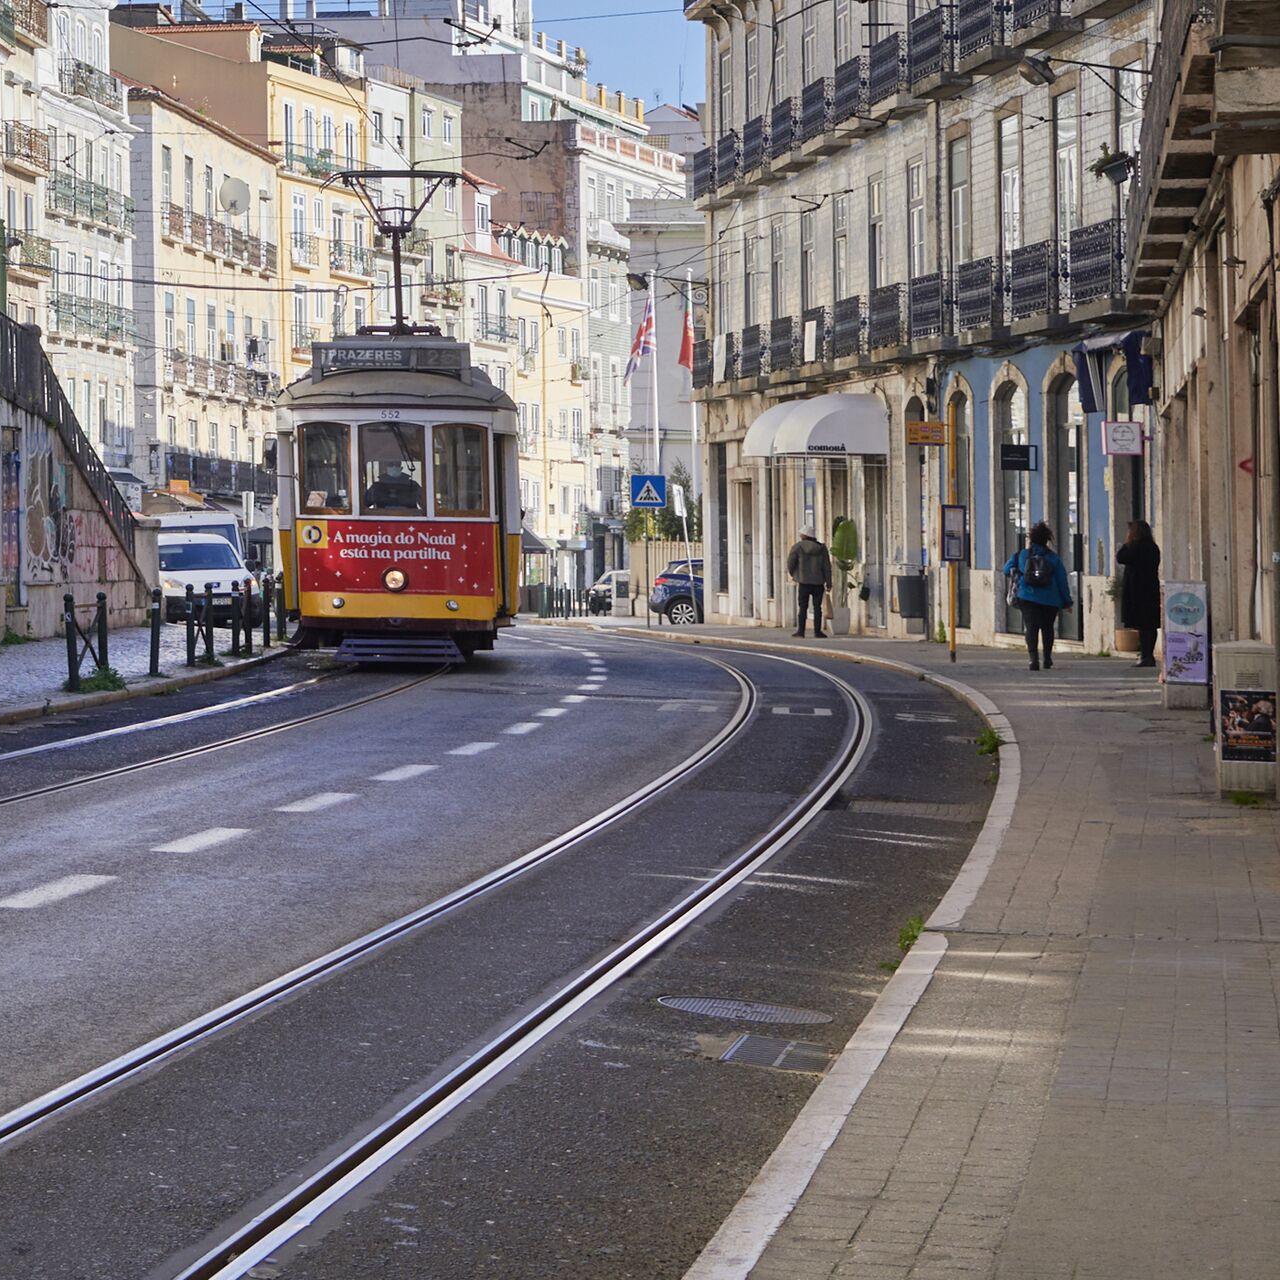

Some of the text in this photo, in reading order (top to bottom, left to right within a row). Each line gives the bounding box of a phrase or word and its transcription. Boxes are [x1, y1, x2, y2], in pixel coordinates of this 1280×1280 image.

[328, 349, 403, 361] PRAZERES
[380, 410, 401, 420] 552
[333, 531, 456, 547] A magia do Natal
[339, 545, 451, 562] está na partilha
